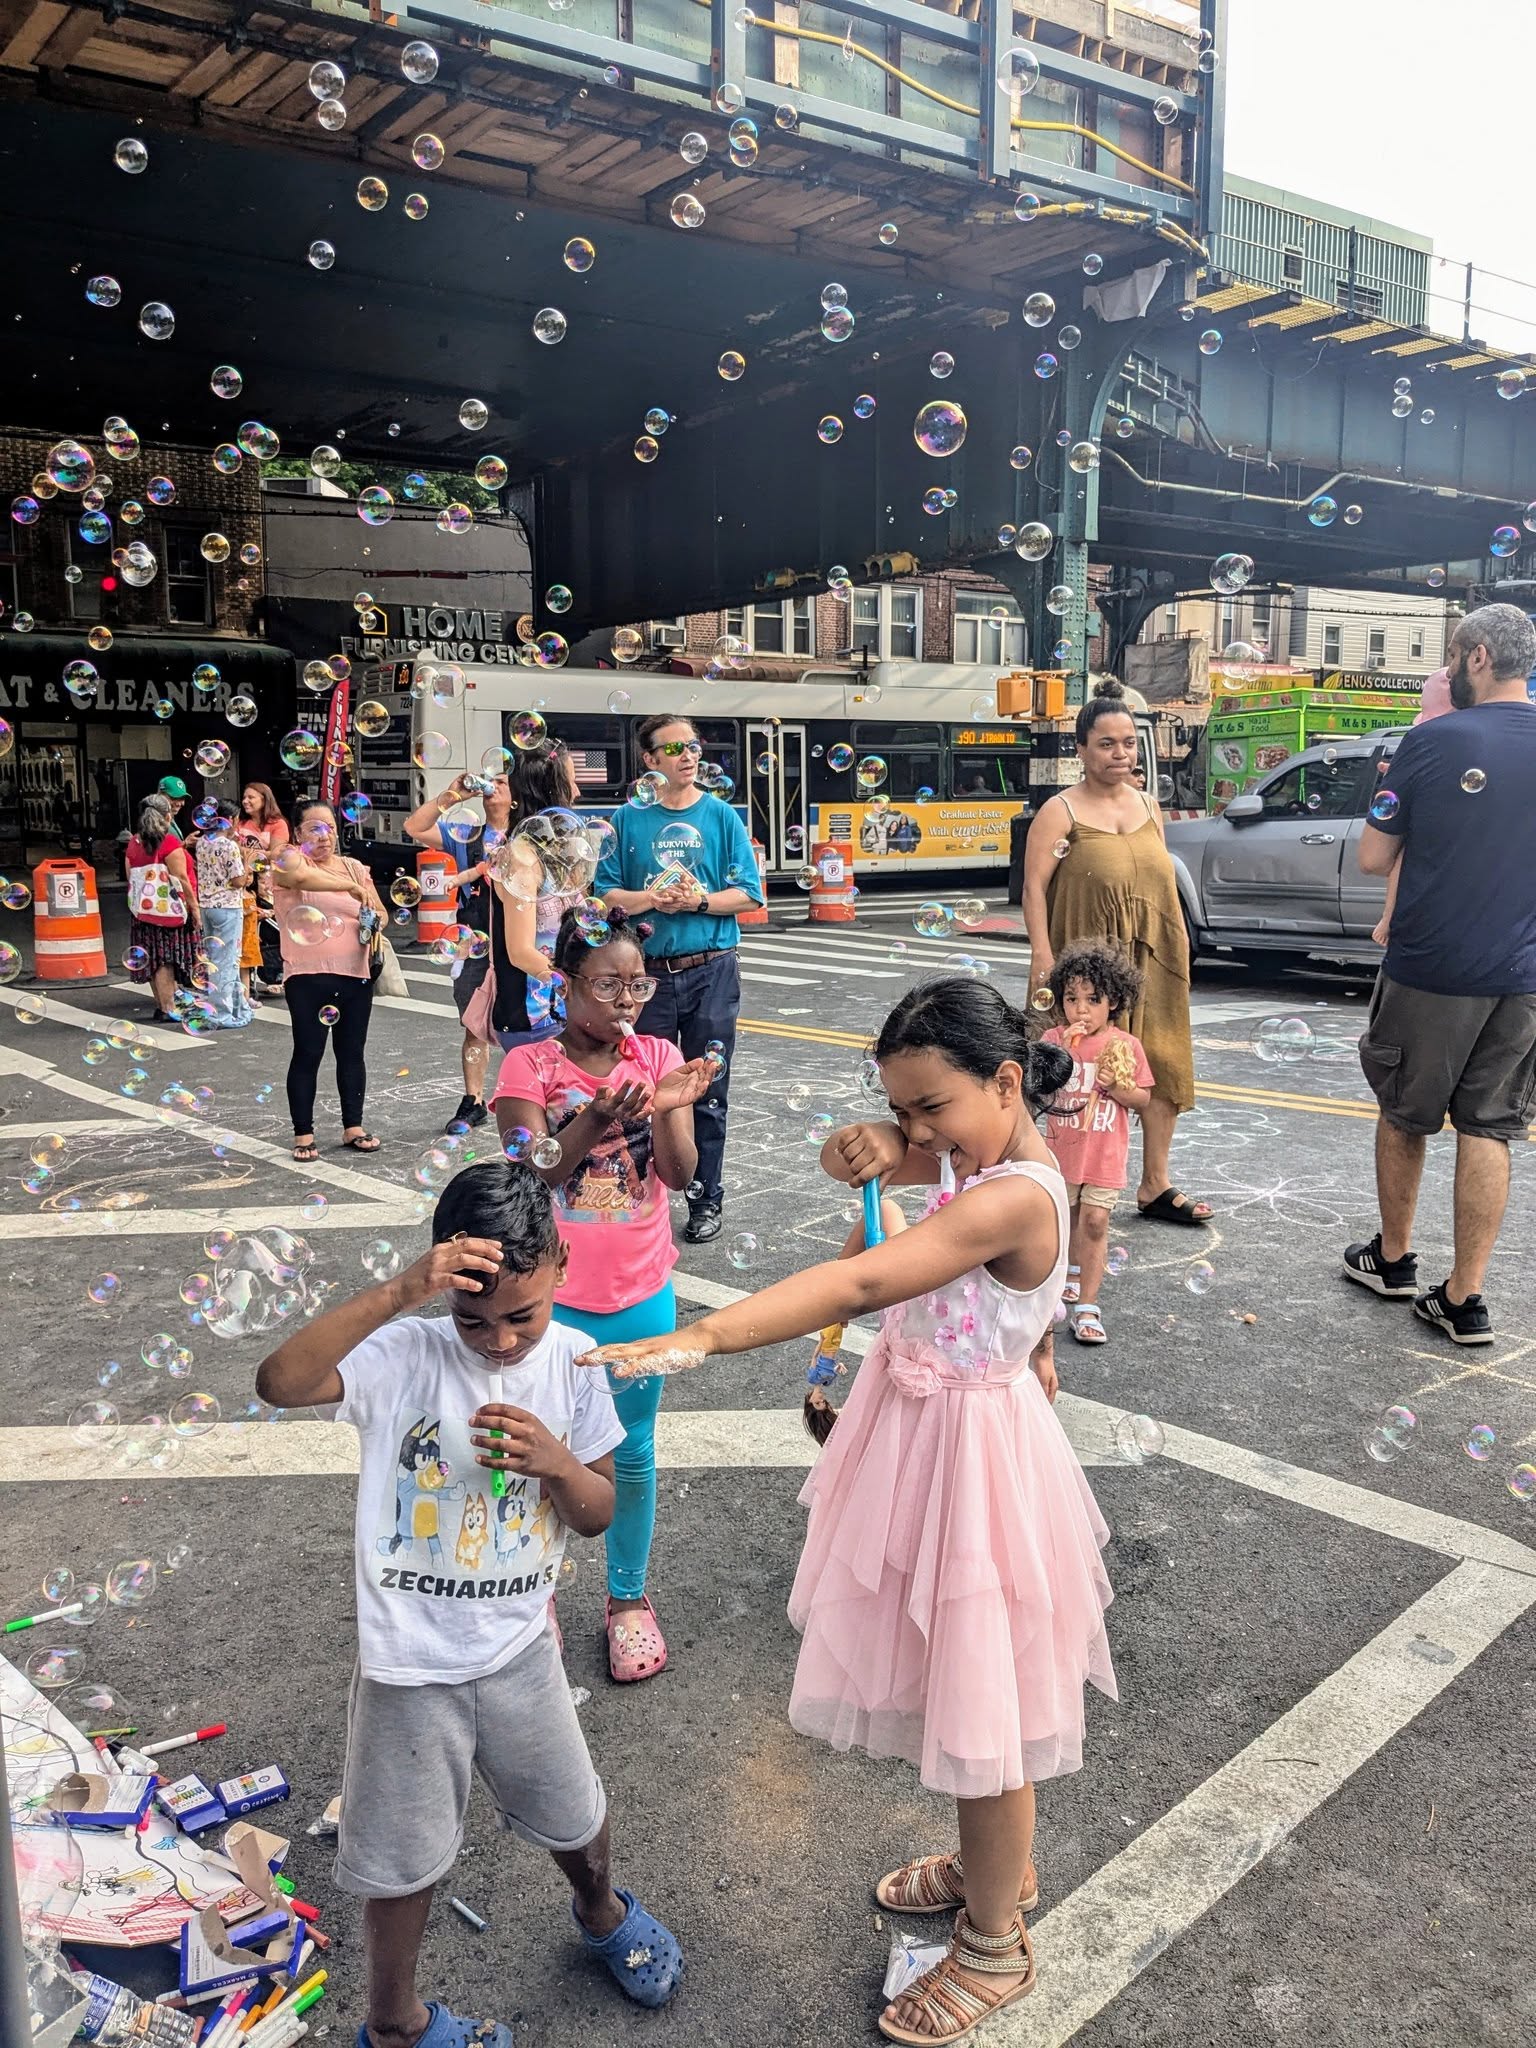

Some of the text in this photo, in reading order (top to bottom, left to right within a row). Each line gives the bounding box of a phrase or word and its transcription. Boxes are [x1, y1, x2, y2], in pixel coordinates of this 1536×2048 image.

[403, 607, 503, 641] HOME
[44, 682, 60, 703] &
[1214, 720, 1245, 734] M & S
[1251, 724, 1270, 734] Food
[1341, 717, 1352, 728] M
[1352, 718, 1360, 728] &
[1361, 718, 1367, 729] S
[1371, 719, 1392, 729] Halal
[327, 690, 344, 801] FURNITURE
[939, 808, 1005, 820] Graduate Faster
[928, 826, 949, 838] With
[668, 850, 686, 858] THE
[379, 1566, 541, 1600] ZECHARIAH
[211, 1975, 247, 1989] MARKERS
